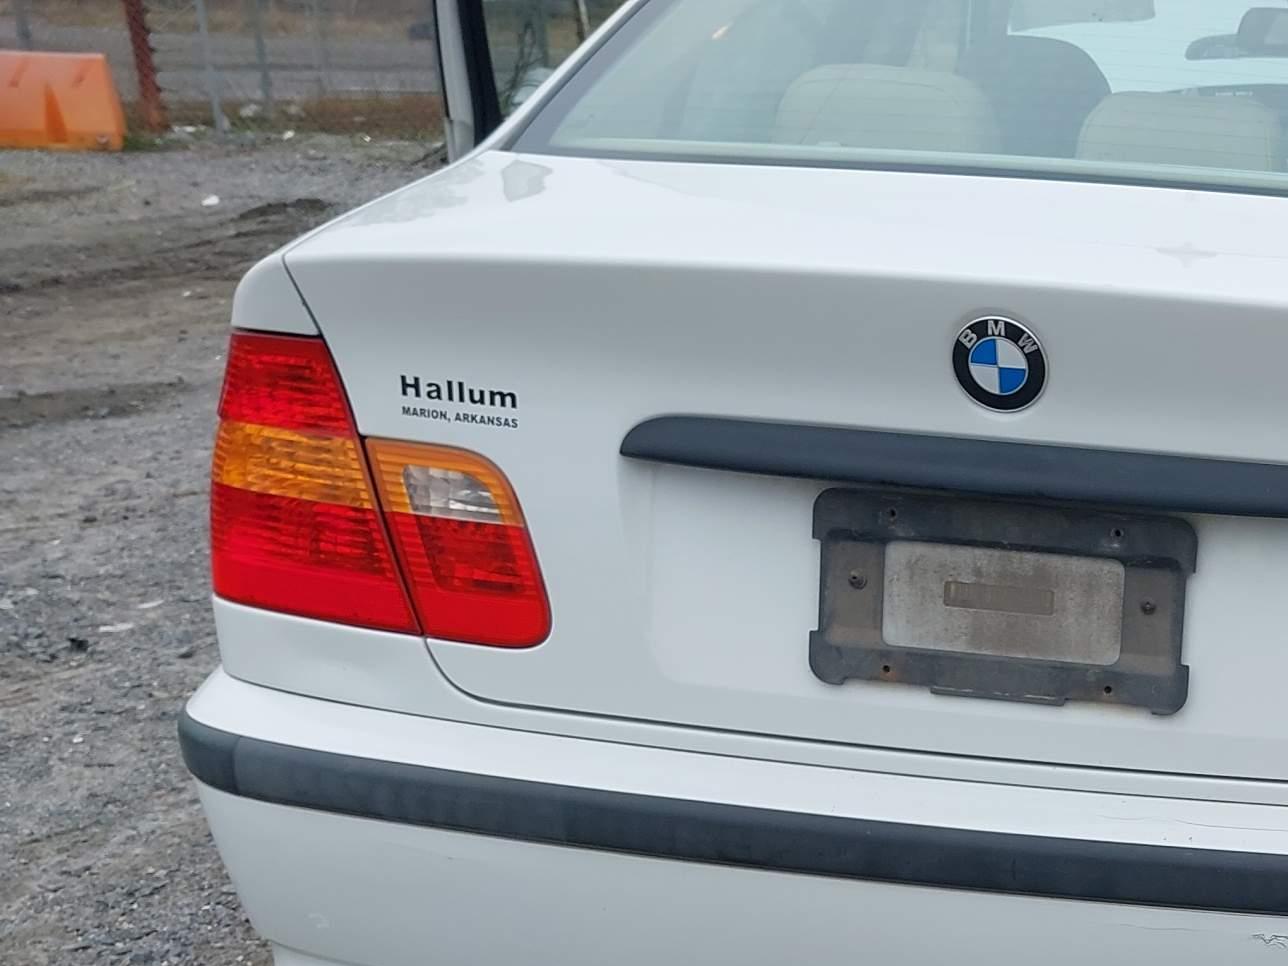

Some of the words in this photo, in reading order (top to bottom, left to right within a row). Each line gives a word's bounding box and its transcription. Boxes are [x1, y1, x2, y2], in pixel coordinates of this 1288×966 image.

[958, 320, 1038, 354] BMW
[400, 375, 518, 409] Hallum
[401, 405, 451, 423] MARION,
[454, 411, 519, 429] ARKANSAS
